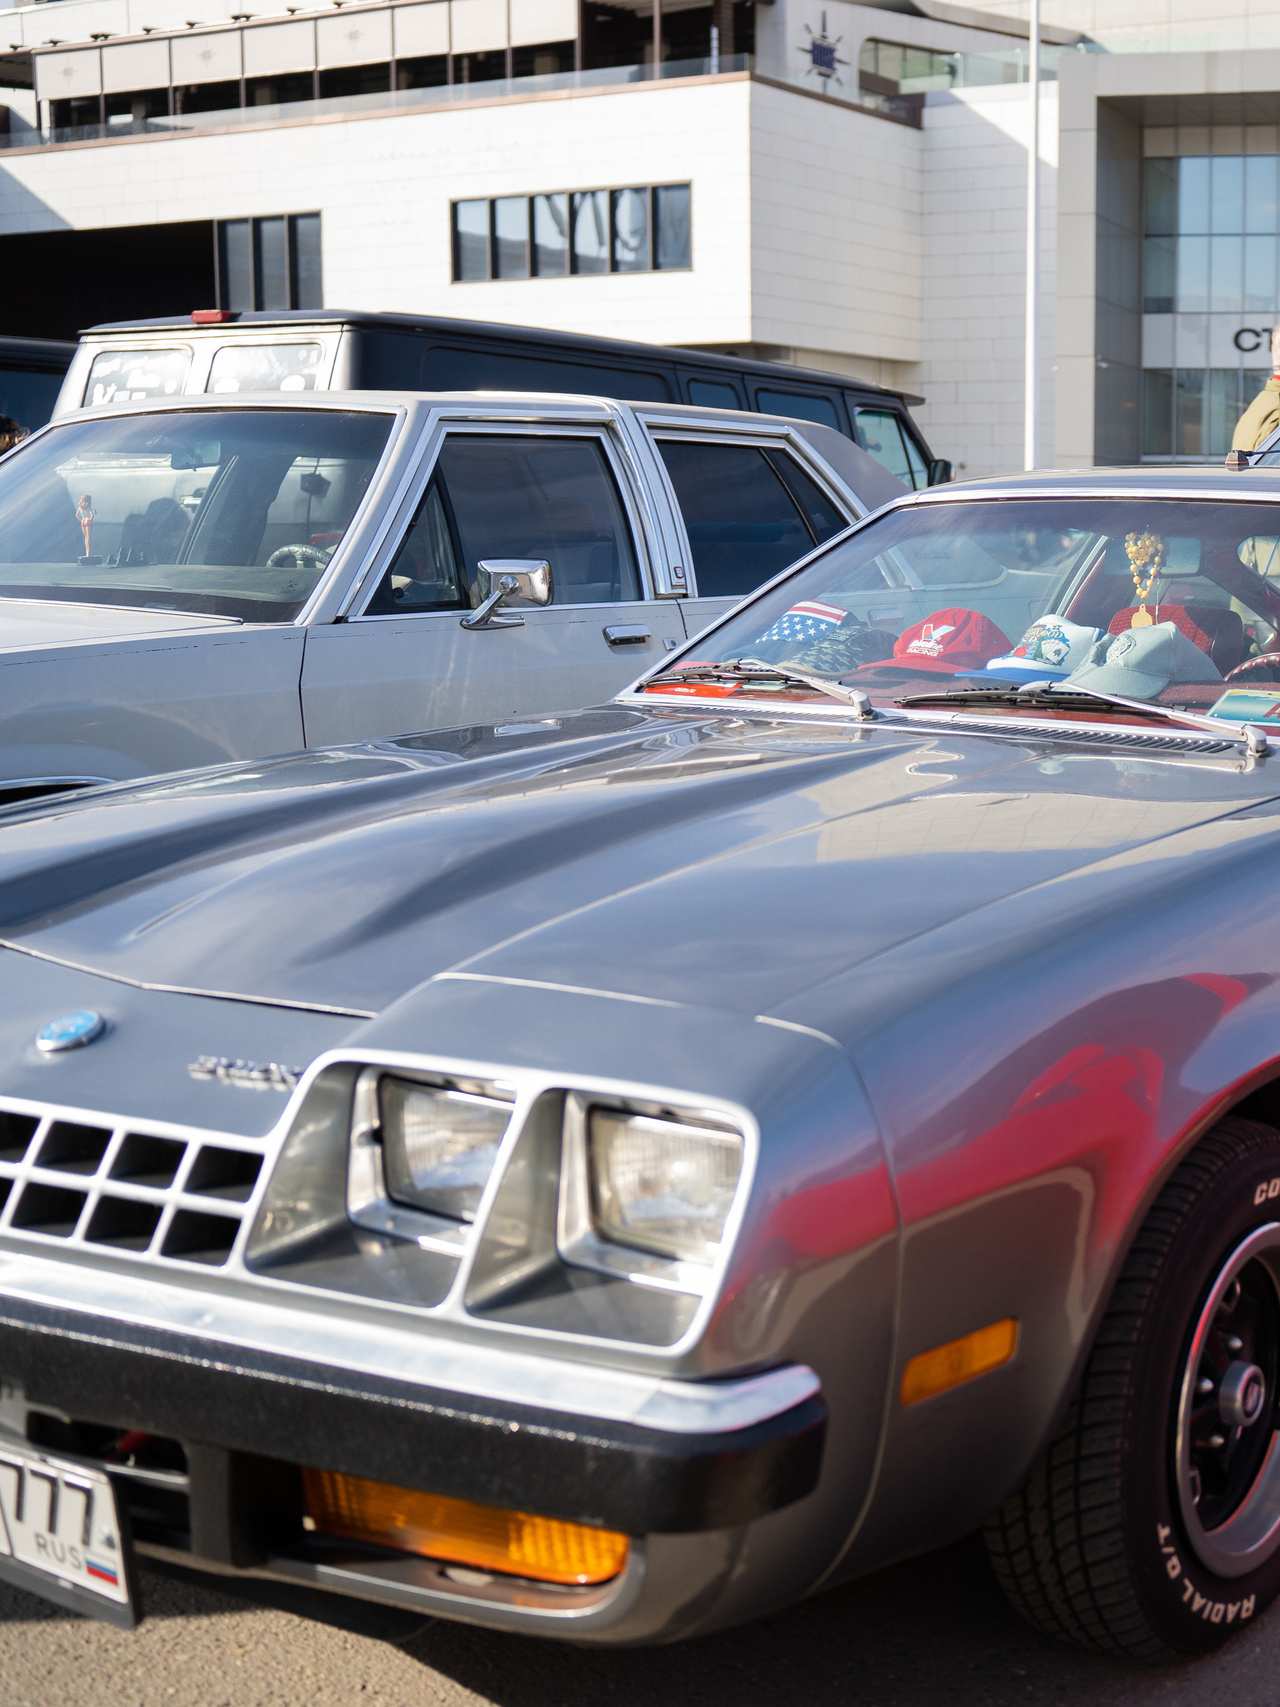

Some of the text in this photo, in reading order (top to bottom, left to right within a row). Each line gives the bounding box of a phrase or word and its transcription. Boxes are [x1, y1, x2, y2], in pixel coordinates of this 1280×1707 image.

[906, 647, 939, 657] RACING
[0, 1458, 94, 1547] 777
[34, 1531, 83, 1572] RUS
[1182, 1577, 1256, 1624] RADIAL
